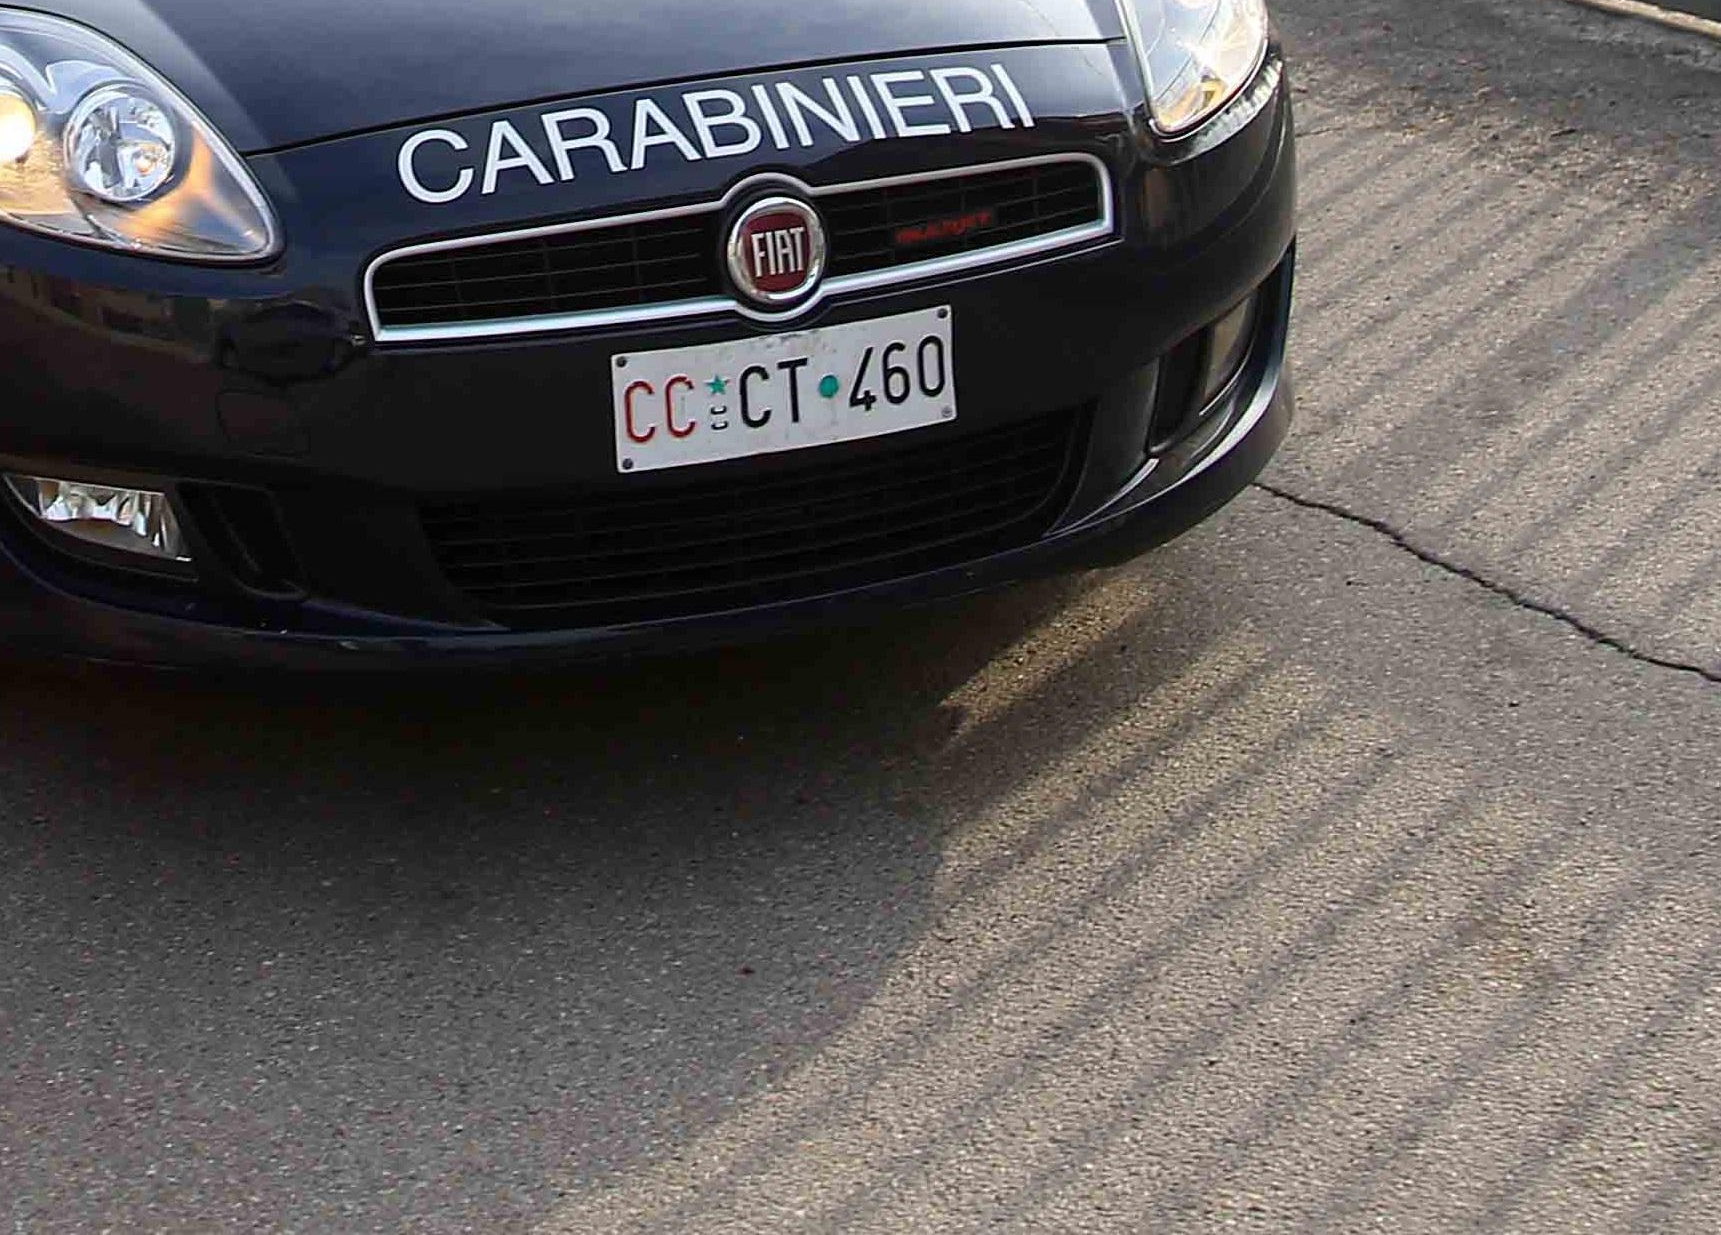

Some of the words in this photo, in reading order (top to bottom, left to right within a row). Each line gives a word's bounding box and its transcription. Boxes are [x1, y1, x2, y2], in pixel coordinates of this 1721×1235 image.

[397, 63, 1035, 204] CARABINIERI
[751, 226, 805, 278] FIAT
[623, 375, 695, 443] CC
[739, 357, 818, 428] CT
[849, 335, 946, 412] 460
